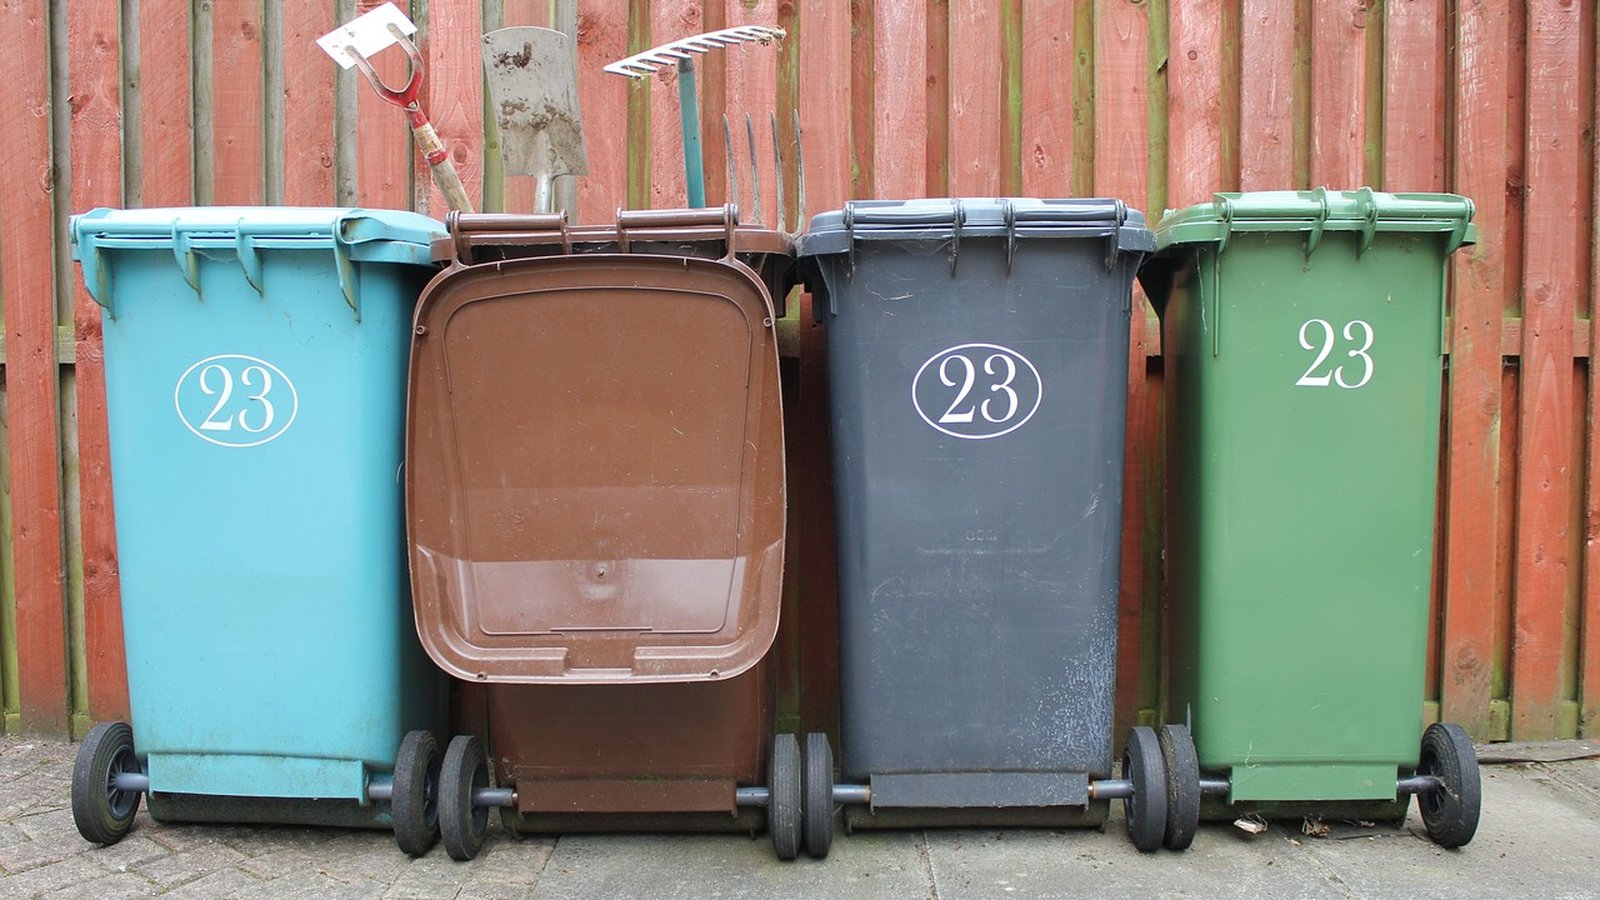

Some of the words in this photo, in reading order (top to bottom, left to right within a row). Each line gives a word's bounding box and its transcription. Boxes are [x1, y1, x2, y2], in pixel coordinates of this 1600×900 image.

[938, 353, 1019, 424] 23
[1295, 319, 1375, 389] 23
[199, 364, 275, 433] 23
